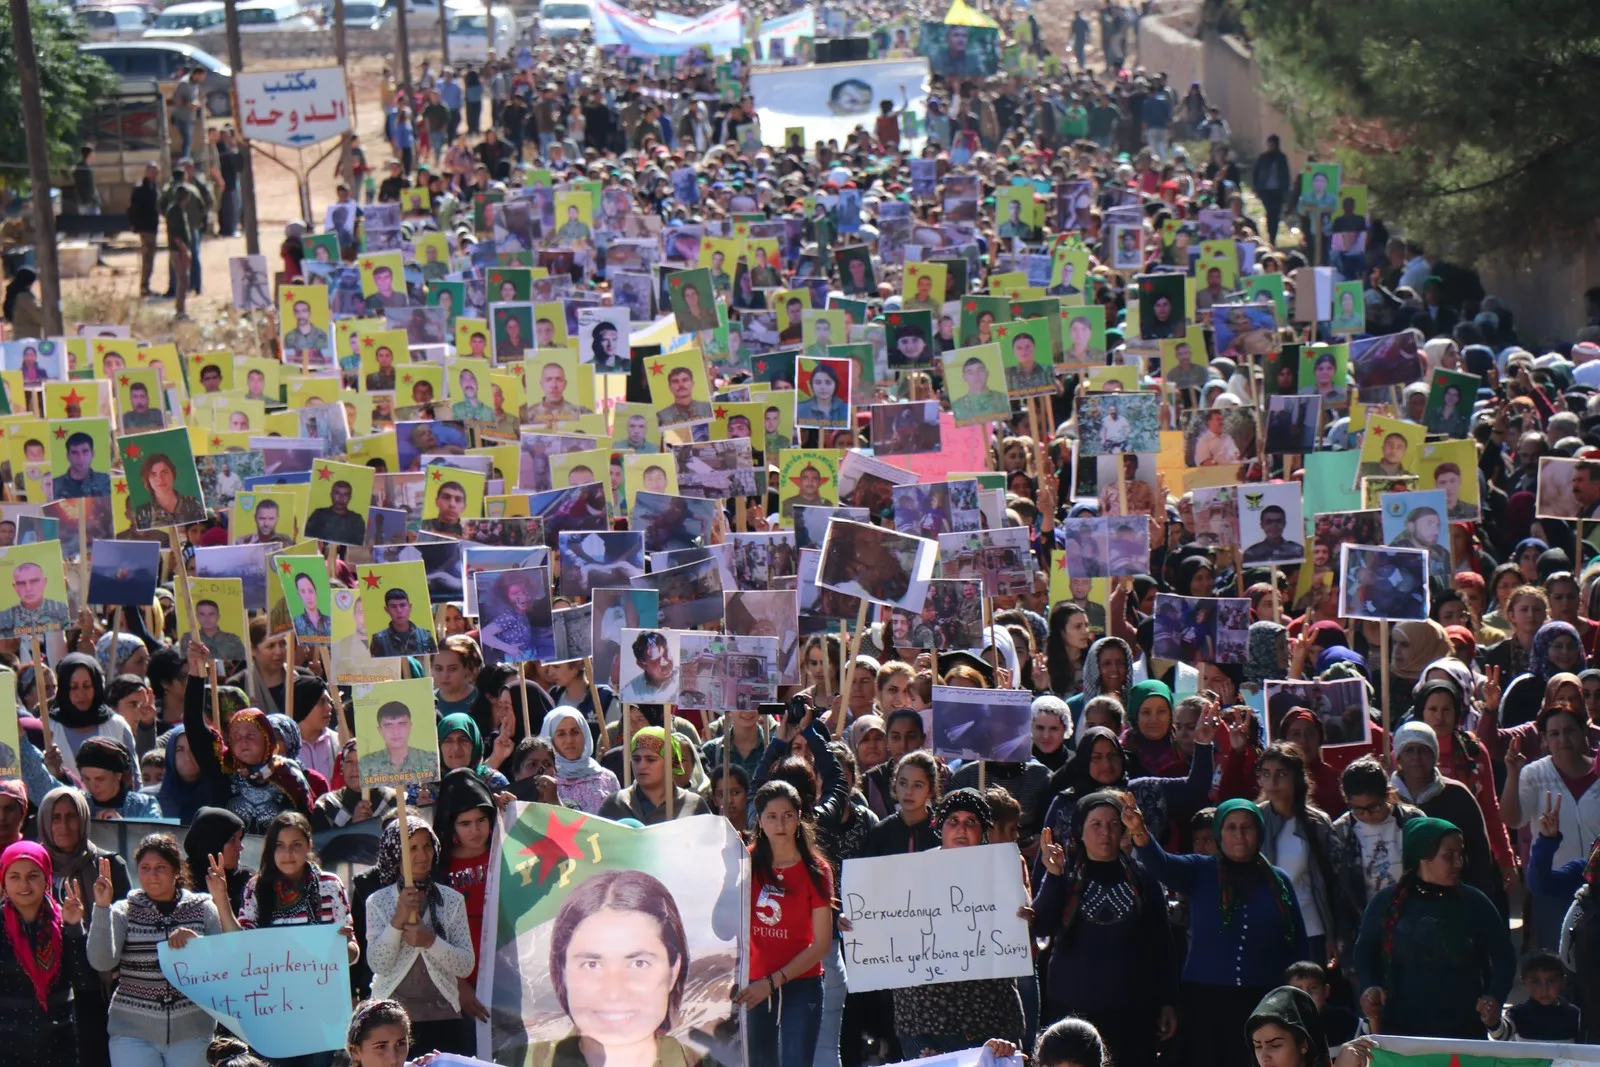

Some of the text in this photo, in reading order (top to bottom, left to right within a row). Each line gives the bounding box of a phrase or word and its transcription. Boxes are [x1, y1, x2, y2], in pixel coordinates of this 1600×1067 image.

[262, 71, 317, 100] مكتب
[245, 99, 345, 132] الدوحة
[756, 884, 786, 927] 5
[949, 885, 998, 932] Rojava
